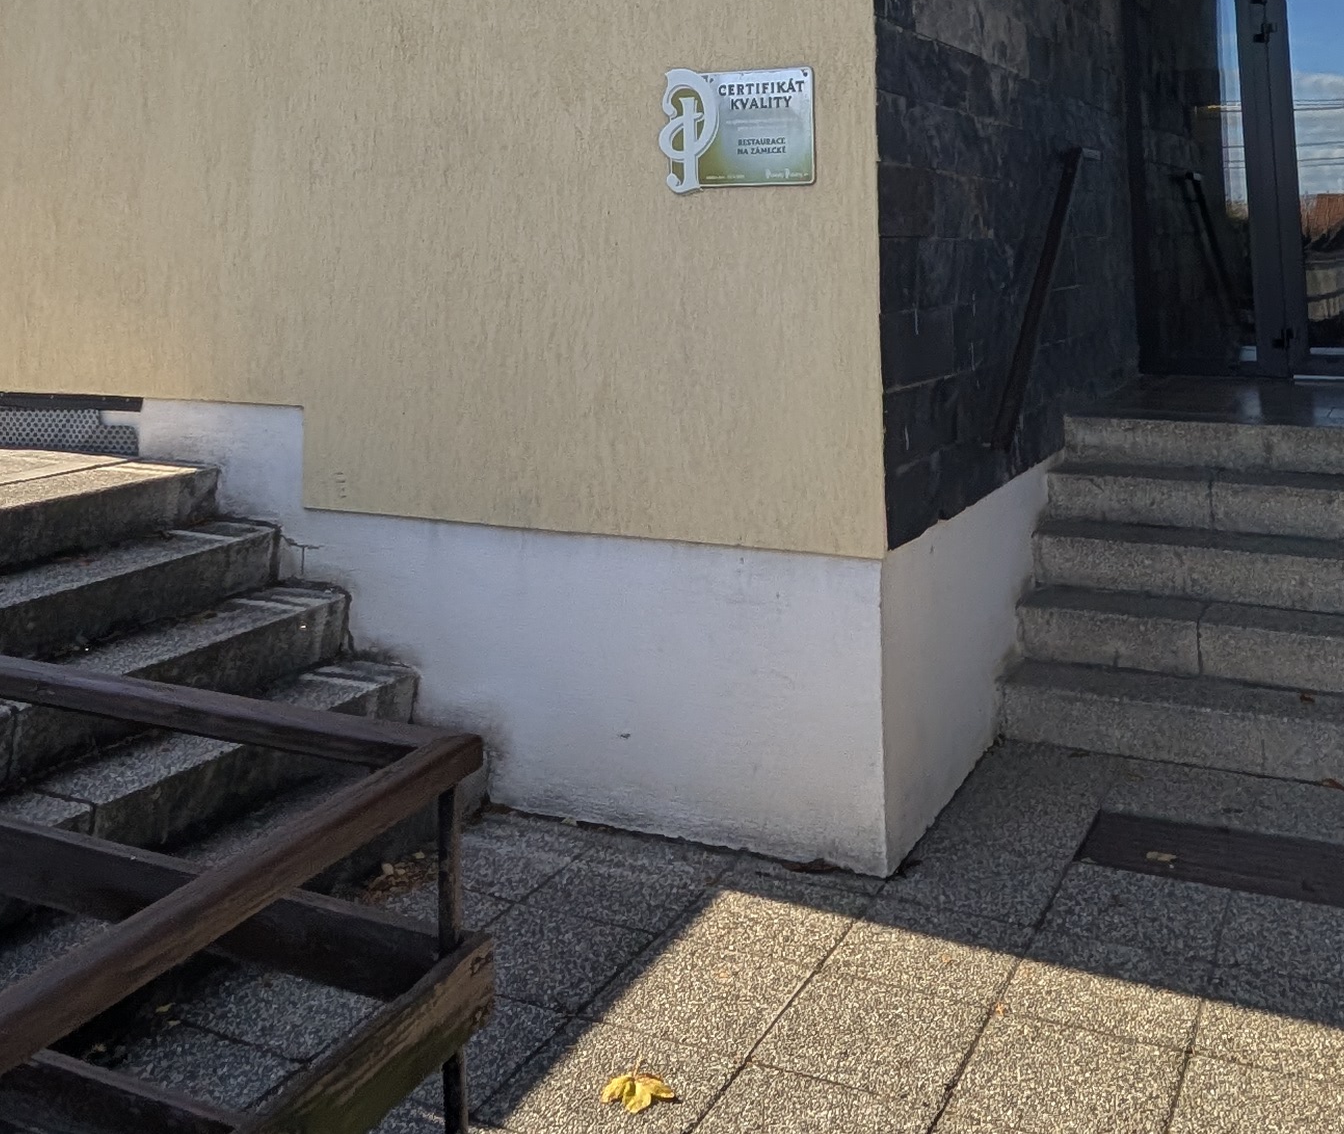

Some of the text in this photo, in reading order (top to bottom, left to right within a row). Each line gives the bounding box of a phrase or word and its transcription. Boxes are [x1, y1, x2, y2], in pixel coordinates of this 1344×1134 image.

[718, 78, 804, 96] CERTIFIKÁT
[730, 96, 792, 110] KVALITY
[738, 137, 786, 146] RESTAURACE
